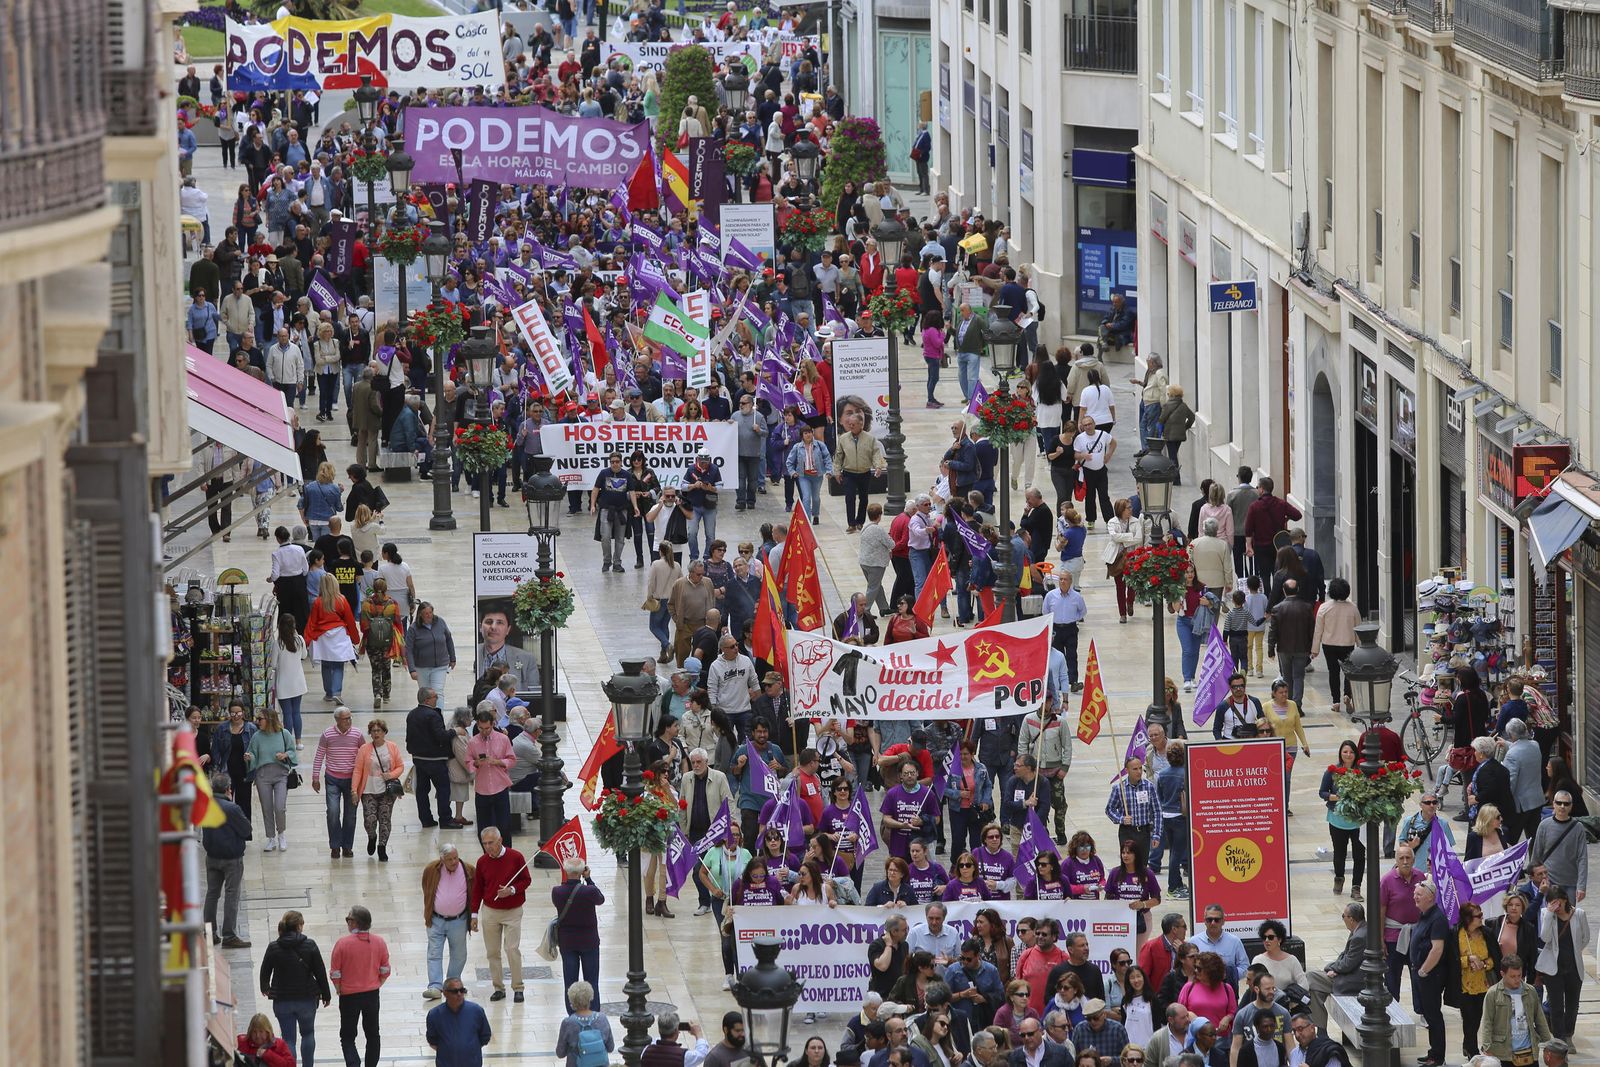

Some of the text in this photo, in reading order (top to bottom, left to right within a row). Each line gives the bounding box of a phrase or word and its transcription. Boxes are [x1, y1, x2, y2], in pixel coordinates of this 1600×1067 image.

[455, 24, 488, 39] Costa
[226, 26, 456, 75] PODEMOS
[639, 46, 669, 57] SIND
[460, 61, 493, 81] SOL
[415, 117, 640, 161] PODEMOS
[439, 154, 629, 175] ES LA HORA DEL CAMBIO
[693, 139, 706, 197] PODEMOS
[514, 168, 553, 178] MÁLAGA
[477, 184, 490, 241] PODEMOS
[1213, 299, 1253, 310] TELEBANCO
[516, 303, 562, 375] CCOO
[686, 294, 707, 369] CCO
[575, 442, 704, 455] EN DEFENSA DE
[557, 456, 725, 470] NUESTO CONVEO
[829, 685, 878, 718] MAYO
[877, 687, 964, 712] decide!
[1204, 766, 1269, 778] BRILLAR ES HACER
[1206, 777, 1267, 788] BRILLAR A OTROS
[1225, 844, 1245, 857] Soles
[1225, 855, 1256, 870] Málaga
[740, 931, 767, 939] CCOO
[1093, 924, 1122, 932] CCOO
[780, 922, 887, 950] ¡¡¡MONIT
[783, 964, 831, 979] EMPLEO
[833, 963, 872, 979] DIGNO
[801, 987, 863, 1002] COMPLETA
